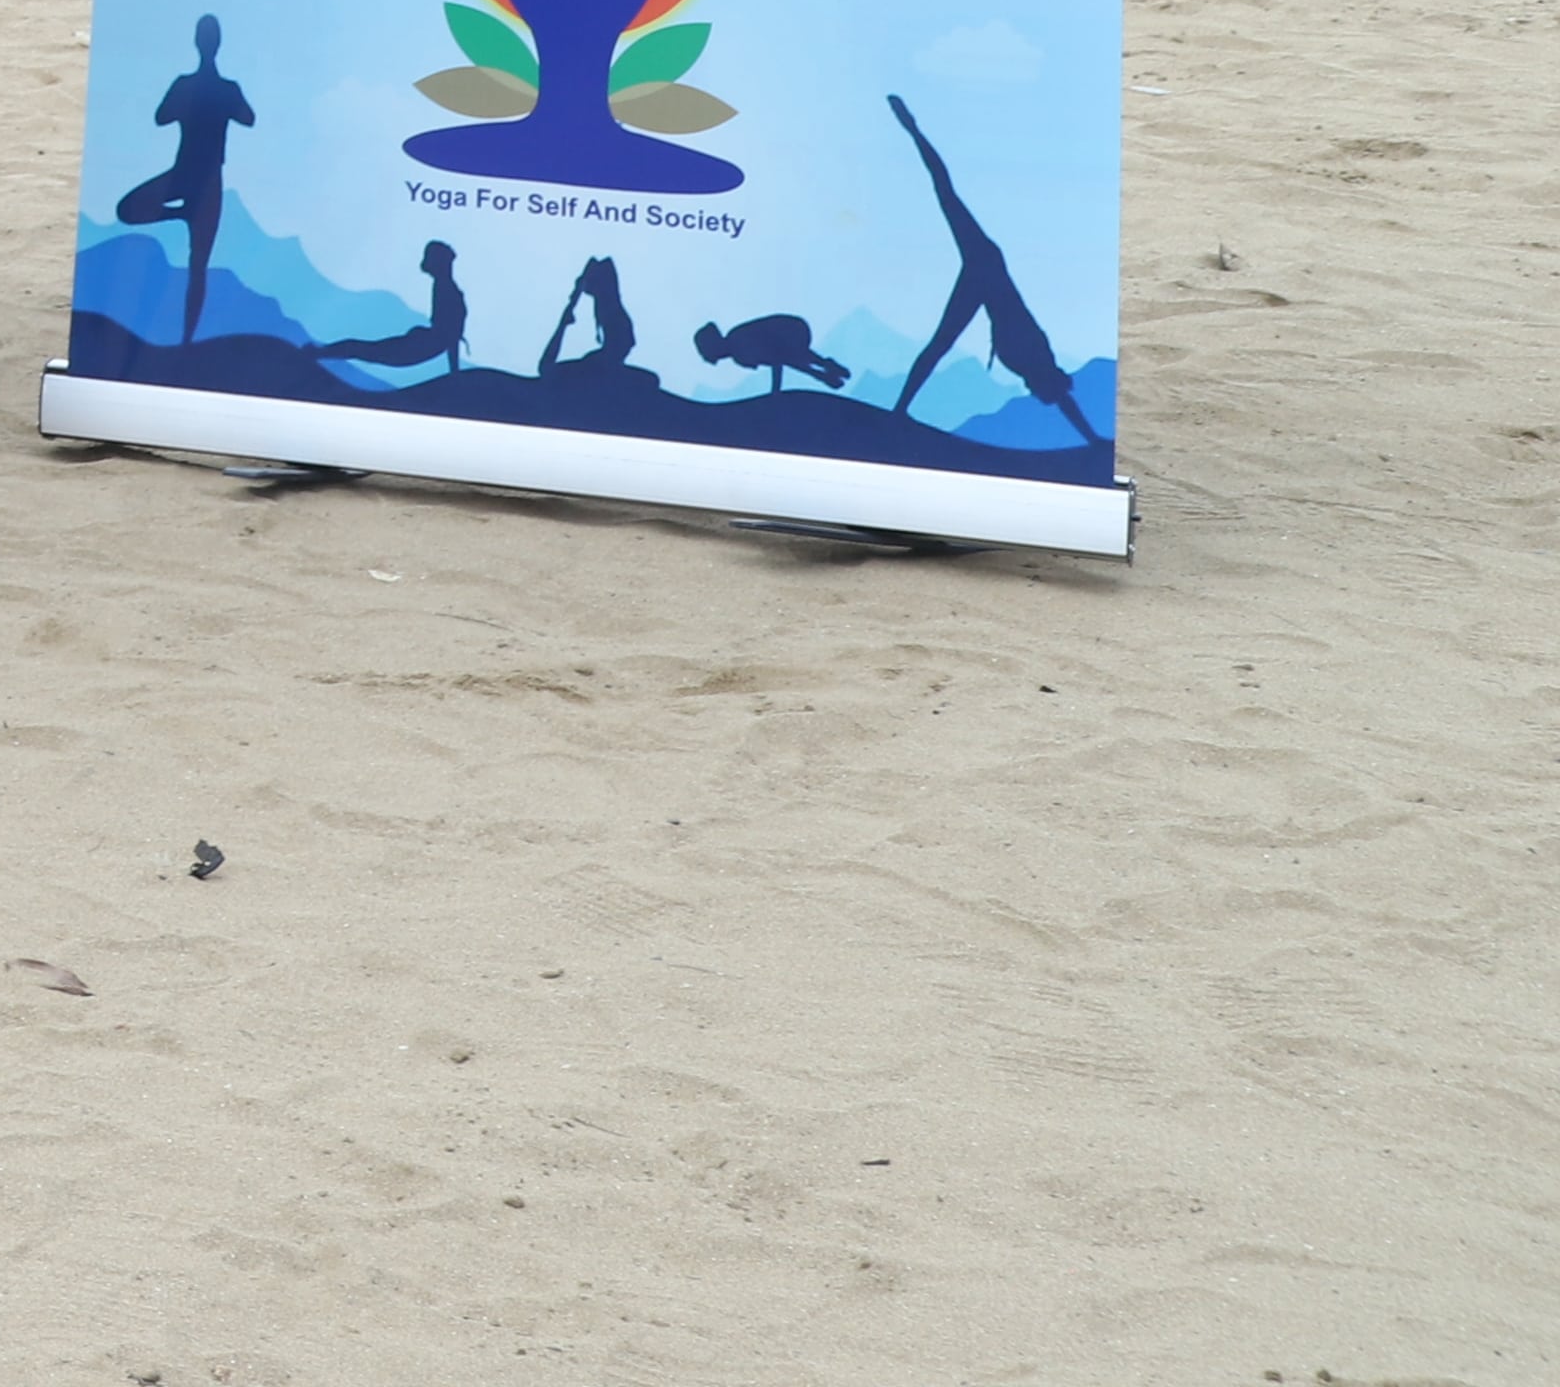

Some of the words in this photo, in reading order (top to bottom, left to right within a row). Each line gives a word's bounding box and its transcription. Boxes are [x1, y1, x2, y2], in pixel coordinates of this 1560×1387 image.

[405, 181, 468, 211] Yoga
[475, 189, 520, 213] For
[526, 193, 577, 219] Self
[583, 200, 637, 224] And
[645, 205, 746, 239] Society
